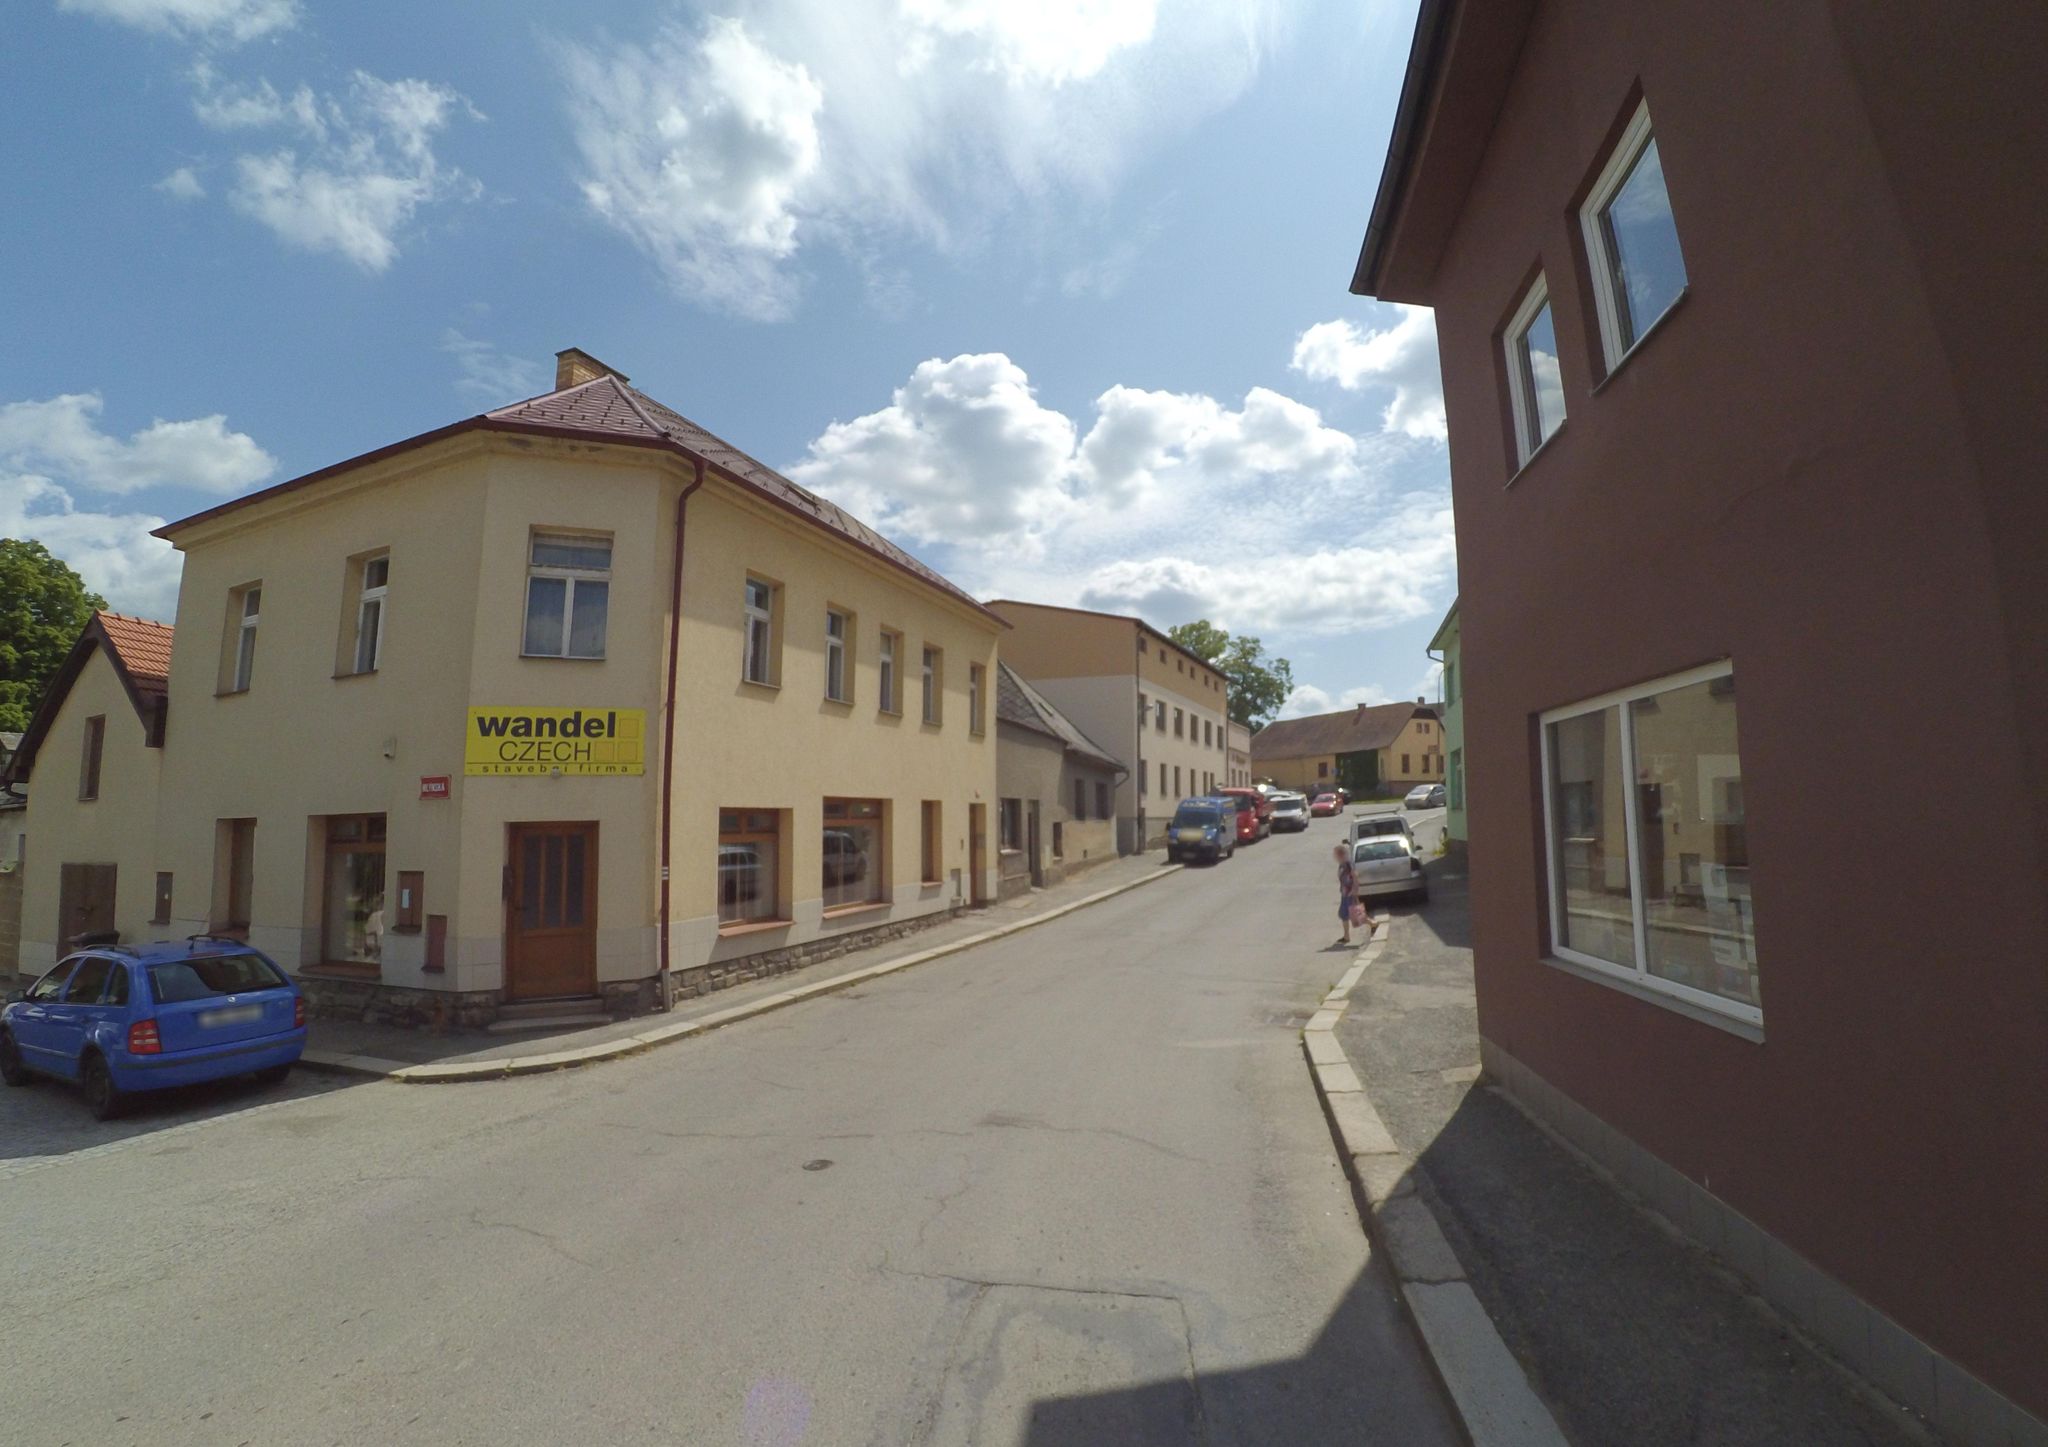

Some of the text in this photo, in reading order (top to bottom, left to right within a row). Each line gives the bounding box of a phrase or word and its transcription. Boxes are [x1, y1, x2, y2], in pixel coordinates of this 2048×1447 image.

[477, 711, 616, 738] wandel
[499, 741, 591, 761] CZECH
[579, 764, 628, 773] firma
